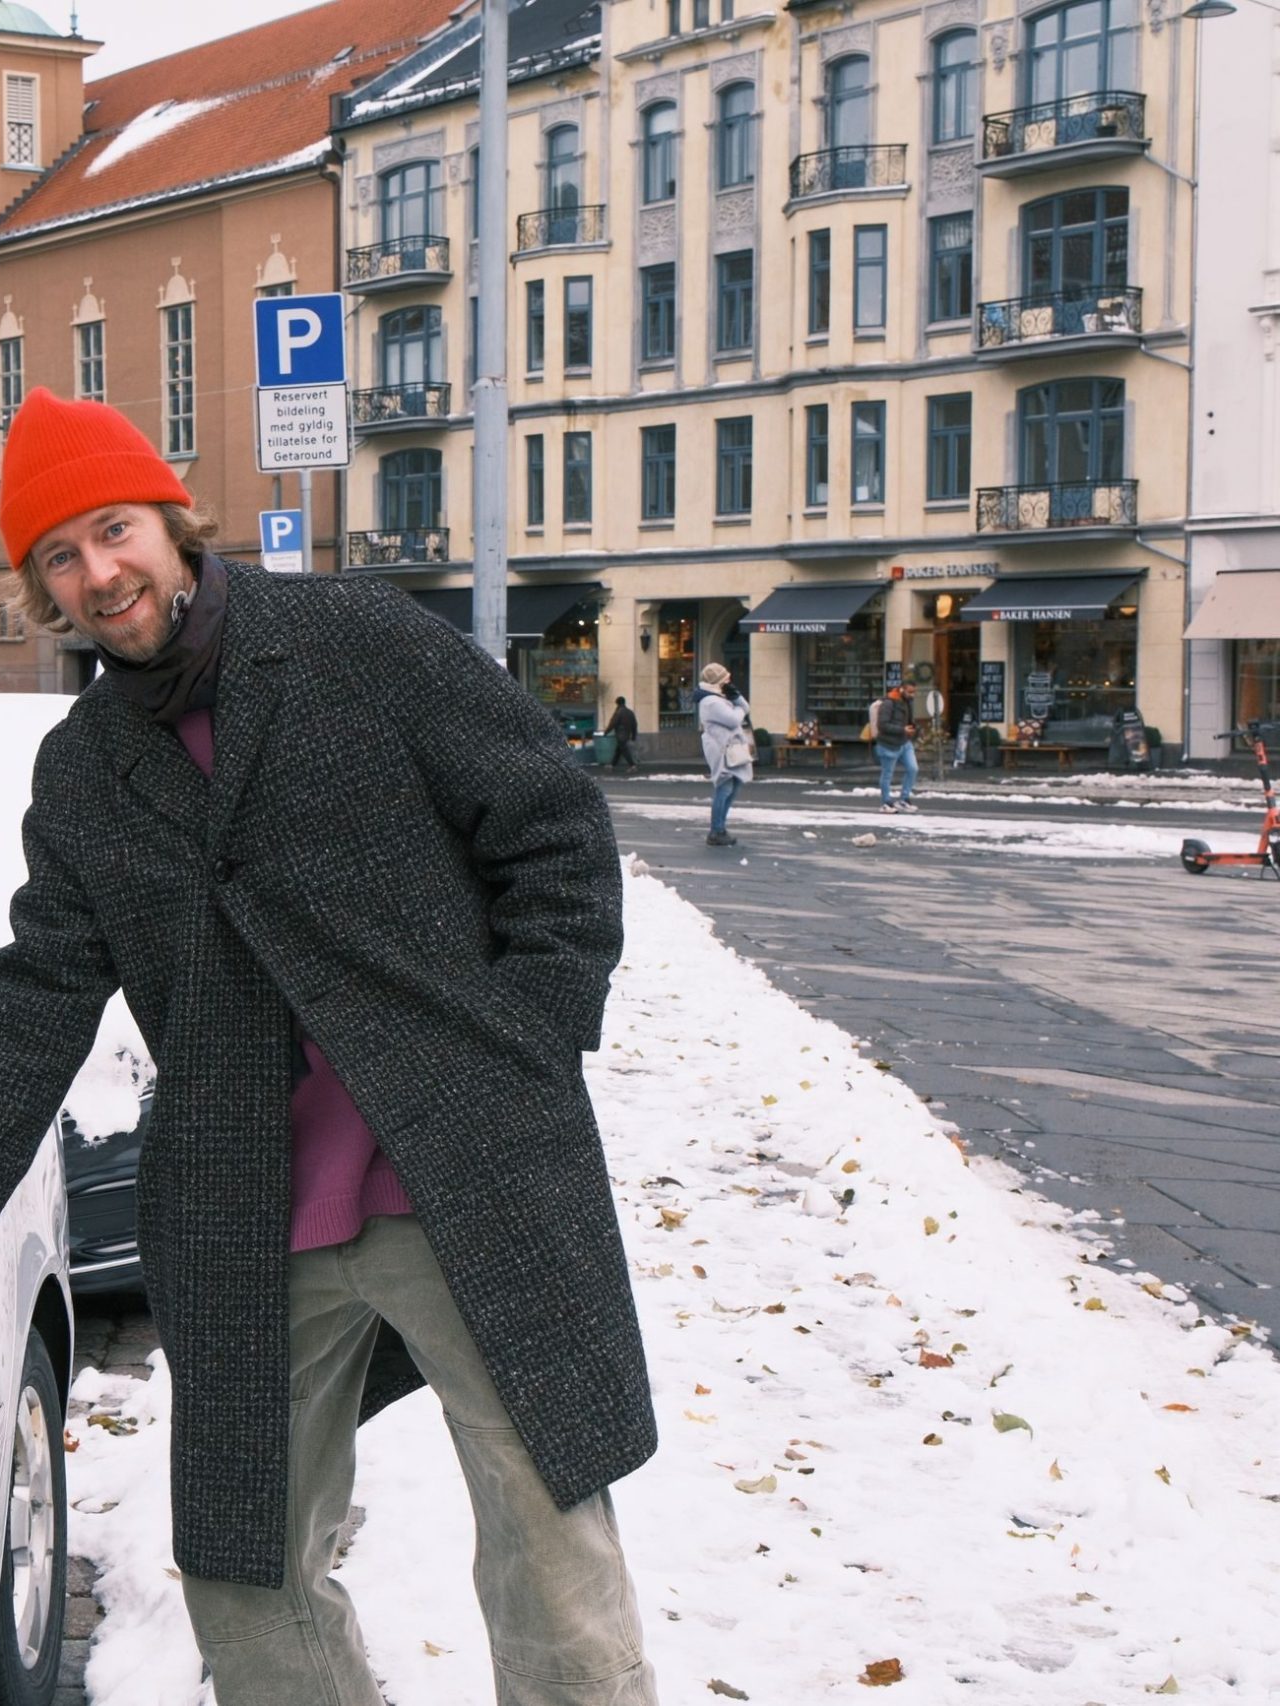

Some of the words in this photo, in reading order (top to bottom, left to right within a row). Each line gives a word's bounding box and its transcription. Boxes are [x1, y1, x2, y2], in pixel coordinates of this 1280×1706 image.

[277, 308, 322, 374] P
[273, 390, 327, 402] Reservert
[277, 405, 325, 417] bildeling
[270, 422, 293, 432] med
[299, 420, 333, 433] gyldig
[268, 435, 317, 447] tillatelse
[322, 434, 337, 444] for
[274, 449, 332, 462] Getaround
[270, 516, 293, 549] P
[905, 566, 943, 578] BAKER
[946, 563, 997, 577] HANSEN
[1000, 611, 1029, 620] BAKER
[1032, 610, 1072, 619] HANSEN
[766, 624, 791, 632] BAKER
[793, 623, 827, 632] HANSEN
